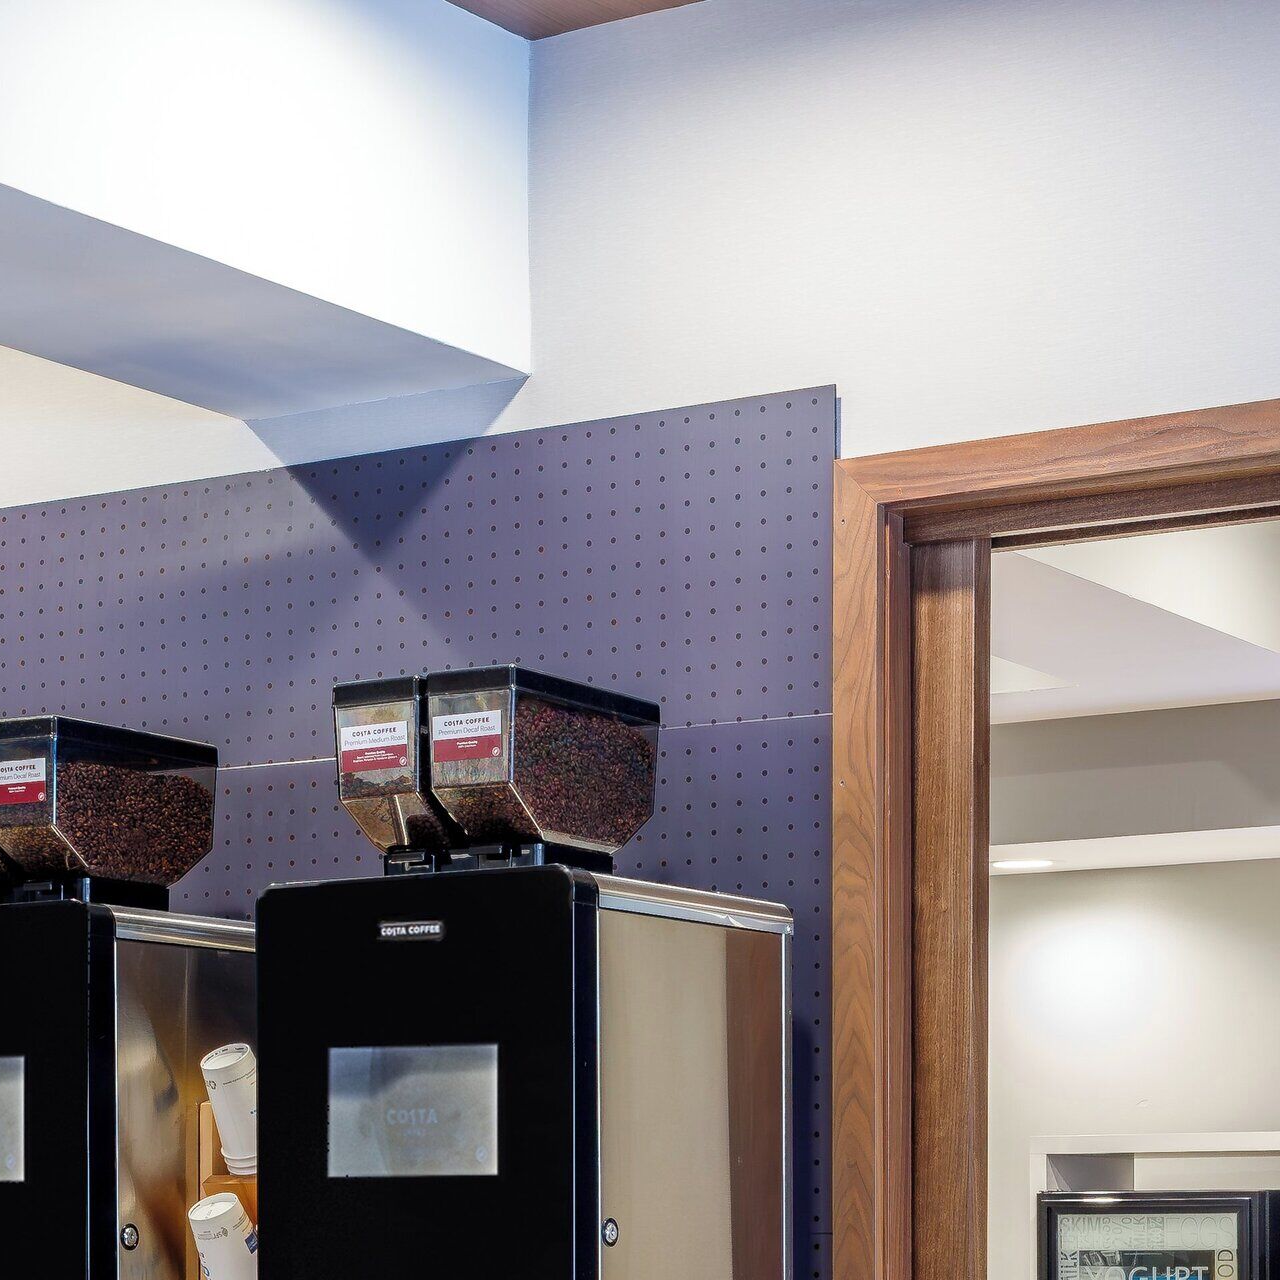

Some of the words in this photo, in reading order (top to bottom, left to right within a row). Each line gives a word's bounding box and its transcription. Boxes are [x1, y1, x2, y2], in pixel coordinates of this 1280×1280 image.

[444, 720, 463, 728] COSTA
[465, 717, 490, 725] COFFEE
[352, 730, 371, 738] COSTA
[373, 727, 397, 735] COFFEE
[438, 727, 462, 736] Premium
[463, 725, 480, 734] Decaf
[480, 724, 496, 732] Roast
[344, 738, 368, 747] Premium
[368, 736, 390, 744] Medium
[391, 734, 406, 742] Roast
[15, 764, 36, 772] COFFEE
[381, 926, 407, 937] COSTA
[408, 924, 441, 935] COFFEE
[386, 1108, 439, 1126] COSTA
[1165, 1216, 1235, 1248] EGGS
